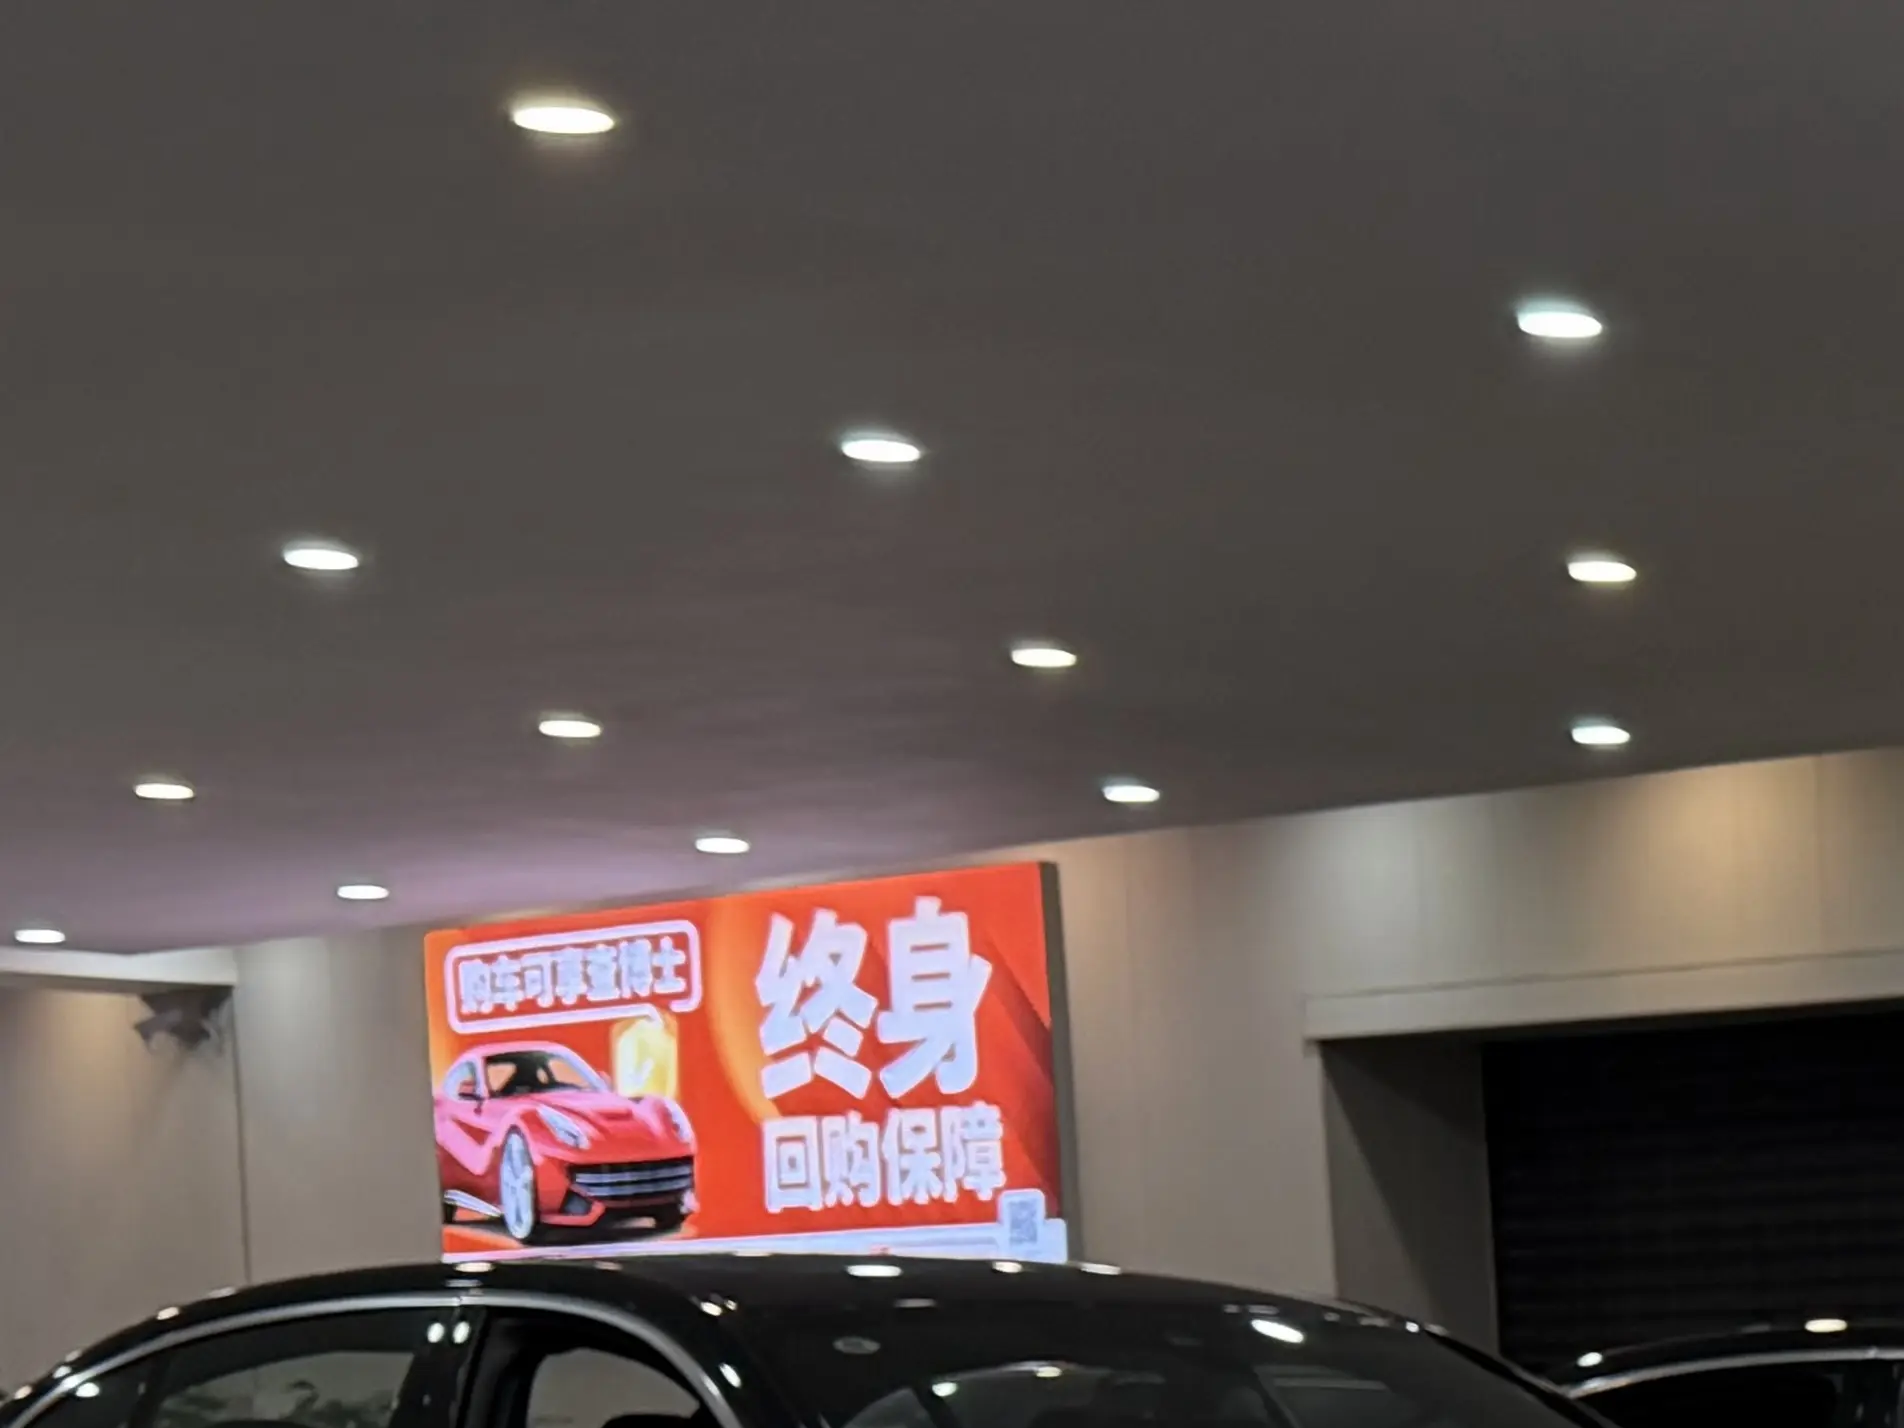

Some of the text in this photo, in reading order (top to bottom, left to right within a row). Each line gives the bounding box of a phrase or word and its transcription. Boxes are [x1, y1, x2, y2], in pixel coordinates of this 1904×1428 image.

[755, 896, 992, 1099] 终身
[763, 1102, 1008, 1213] 回购保障
